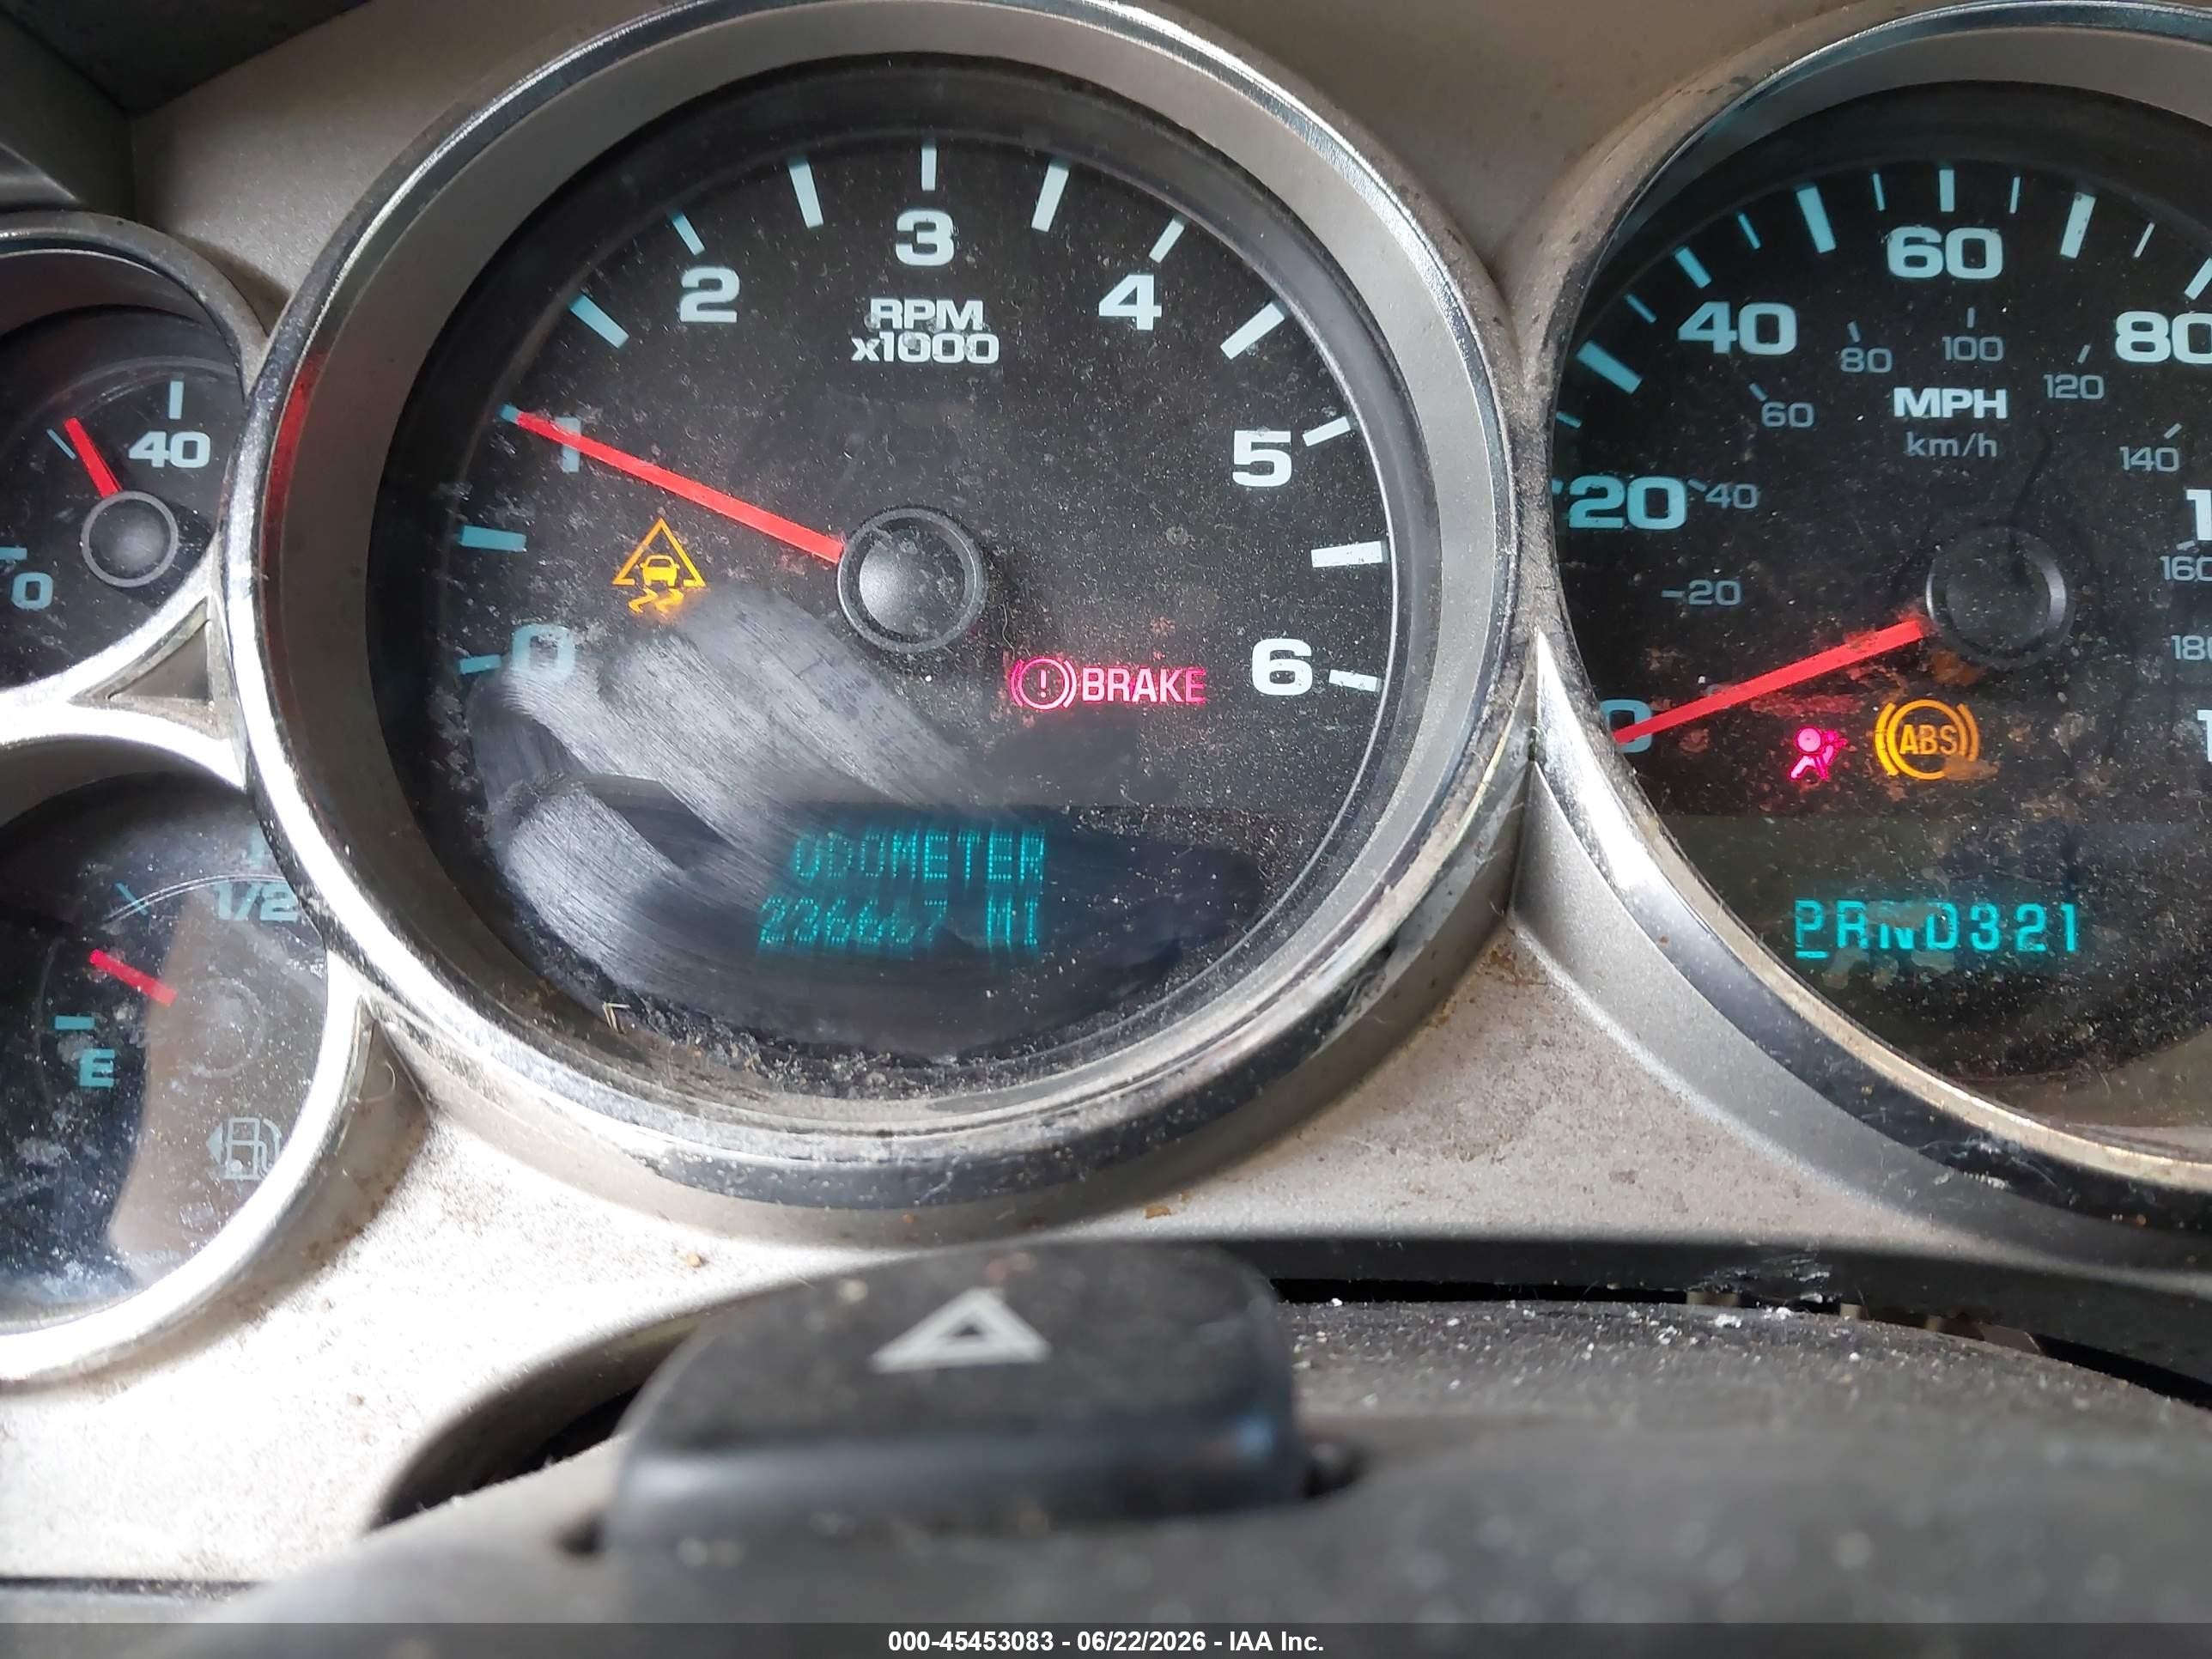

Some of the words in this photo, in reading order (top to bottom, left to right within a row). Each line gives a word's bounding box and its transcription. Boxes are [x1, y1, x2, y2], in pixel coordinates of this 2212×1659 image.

[896, 209, 954, 266] 3
[1887, 226, 2002, 279] 60
[680, 266, 740, 323] 2
[1099, 274, 1162, 330] 4
[870, 298, 984, 331] RPM
[1679, 301, 1797, 356] 40
[851, 332, 1000, 363] x1000
[1942, 336, 2003, 362] 100
[2115, 311, 2212, 364] 80
[1840, 348, 1893, 373] 80
[1893, 387, 2008, 418] MPH
[2044, 374, 2105, 399] 120
[1762, 402, 1814, 428] 60
[129, 431, 210, 467] 40
[556, 417, 580, 473] 1
[1232, 430, 1291, 487] 5
[1905, 431, 1997, 457] km/h
[2119, 446, 2179, 471] 140
[1569, 475, 1686, 530] 20
[1705, 483, 1759, 508] 40
[11, 573, 53, 610] 0
[1689, 580, 1741, 605] 20
[513, 624, 575, 684] 0
[2172, 635, 2212, 661] 18
[1082, 667, 1206, 702] BRAKE
[1252, 639, 1312, 696] 6
[1899, 725, 1957, 756] ABS
[796, 831, 1045, 880] ODOMETER
[212, 882, 299, 921] 1/2
[987, 898, 1038, 945] MI
[78, 1048, 115, 1087] E
